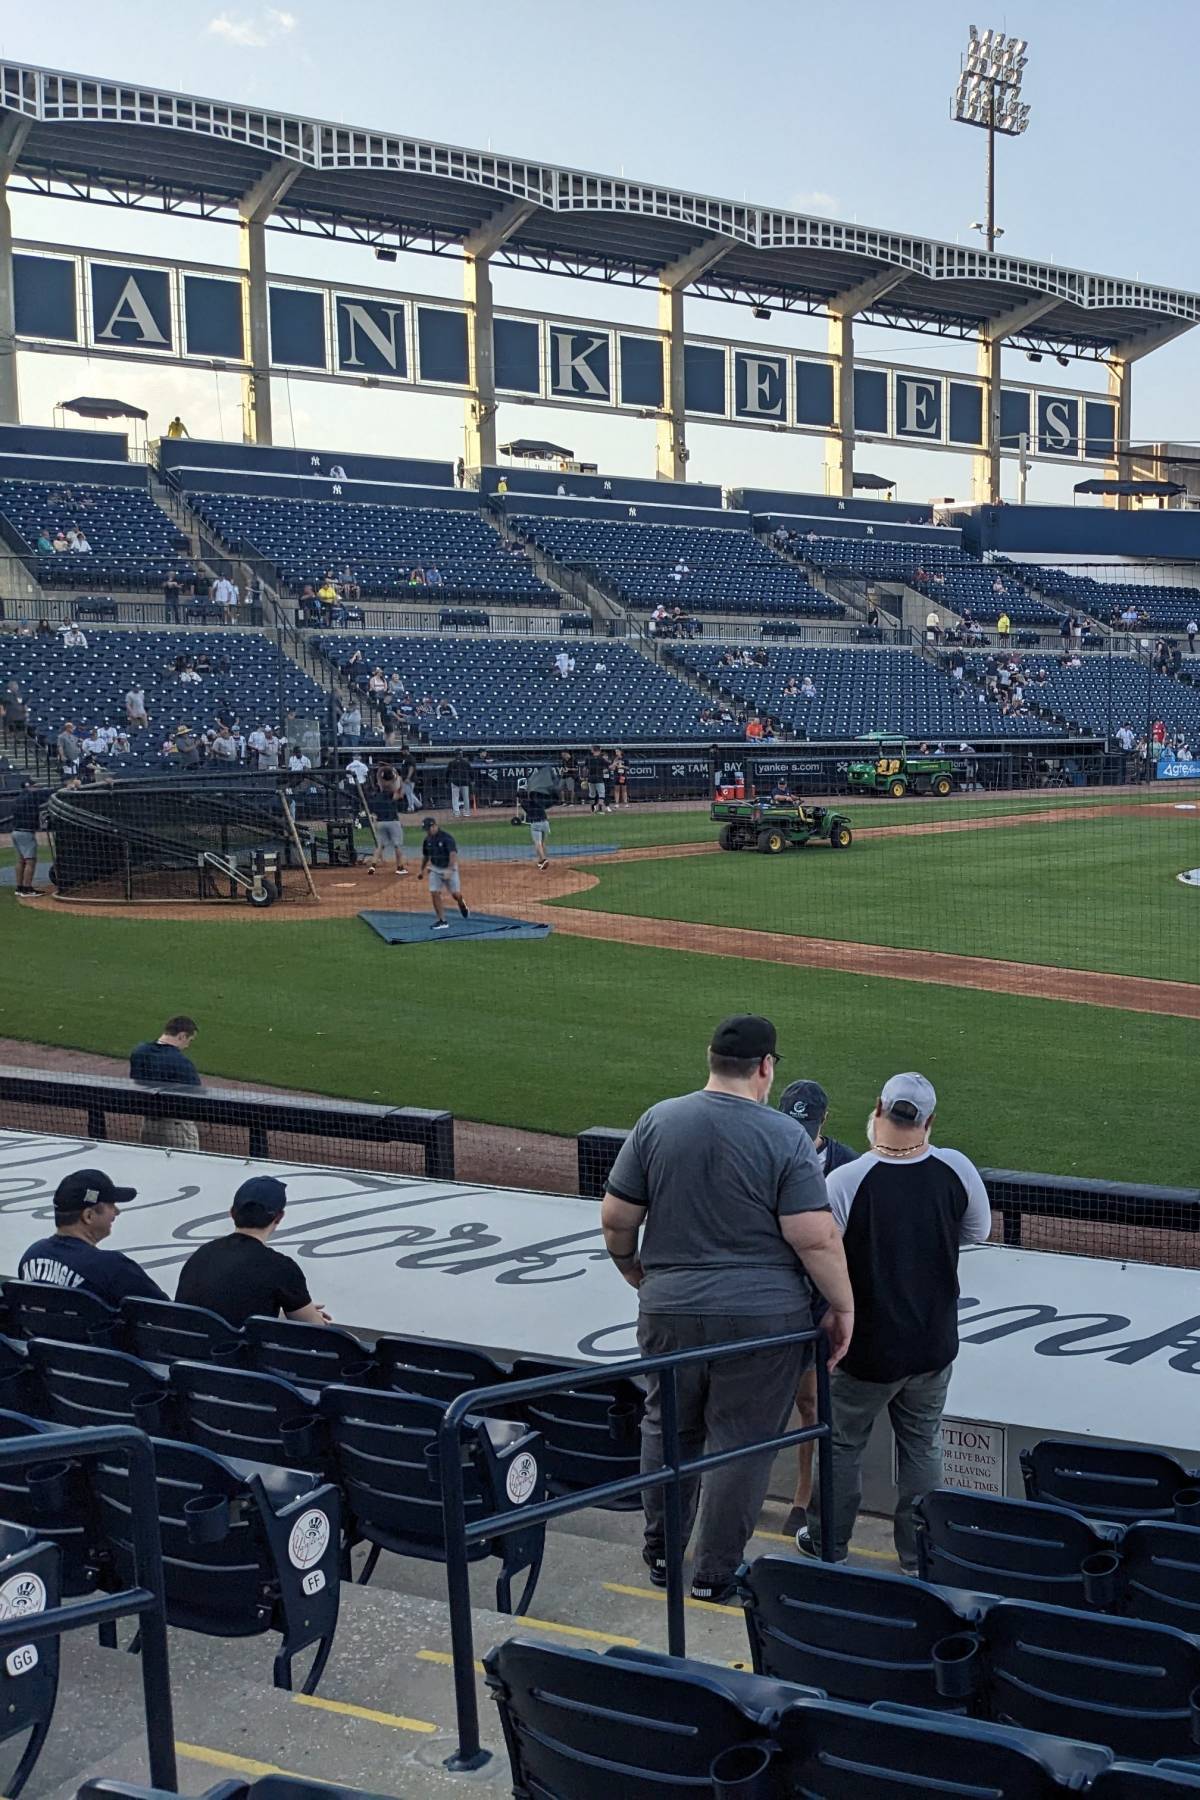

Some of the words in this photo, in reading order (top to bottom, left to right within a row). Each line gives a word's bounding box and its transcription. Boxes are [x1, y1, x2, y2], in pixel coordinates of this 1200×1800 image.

[724, 762, 743, 772] BAY
[759, 762, 820, 774] yankes.com
[942, 1429, 991, 1451] TION
[955, 1450, 973, 1461] LIVE
[974, 1454, 996, 1465] BATS
[954, 1464, 991, 1478] LEAVING
[956, 1478, 971, 1489] ALL
[973, 1480, 999, 1493] TIMES
[307, 1573, 320, 1591] FF
[13, 1649, 33, 1671] GG
